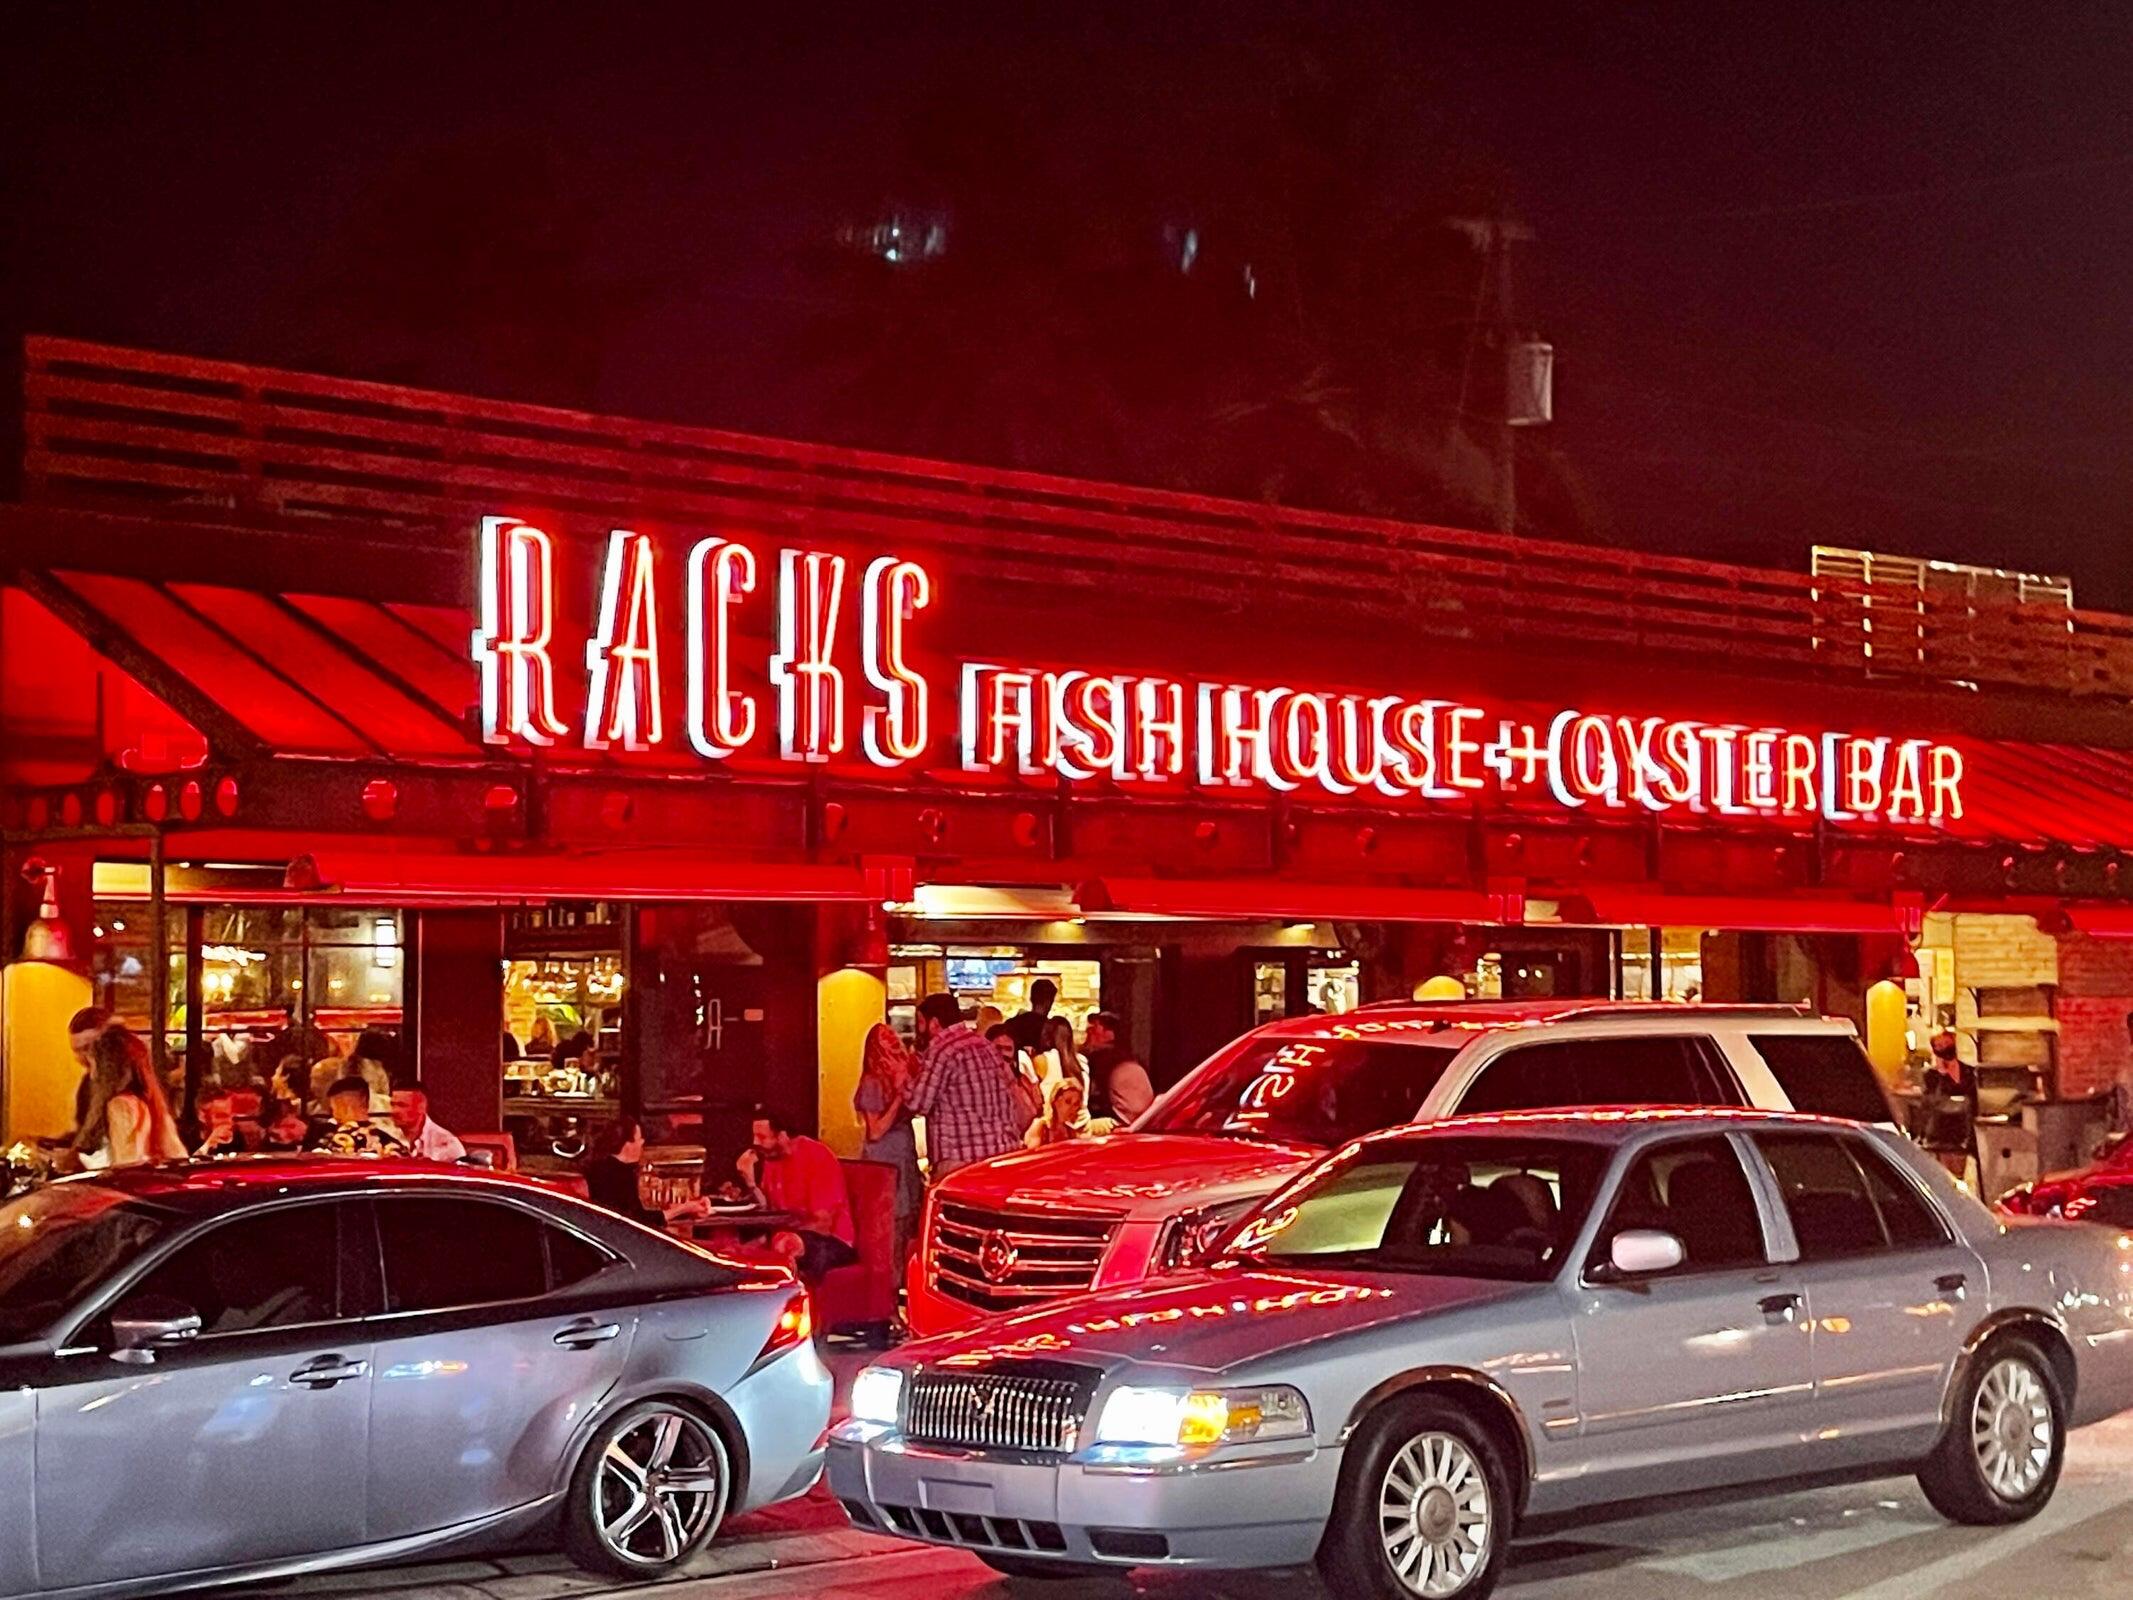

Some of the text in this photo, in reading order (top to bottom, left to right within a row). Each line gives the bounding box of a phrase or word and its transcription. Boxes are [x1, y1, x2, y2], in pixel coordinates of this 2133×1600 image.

[472, 515, 930, 768] RACKS
[962, 663, 1183, 780] FISH
[1197, 682, 1486, 798] HOUSE
[1547, 710, 1818, 817] OYSTER
[1823, 733, 1964, 827] BAR
